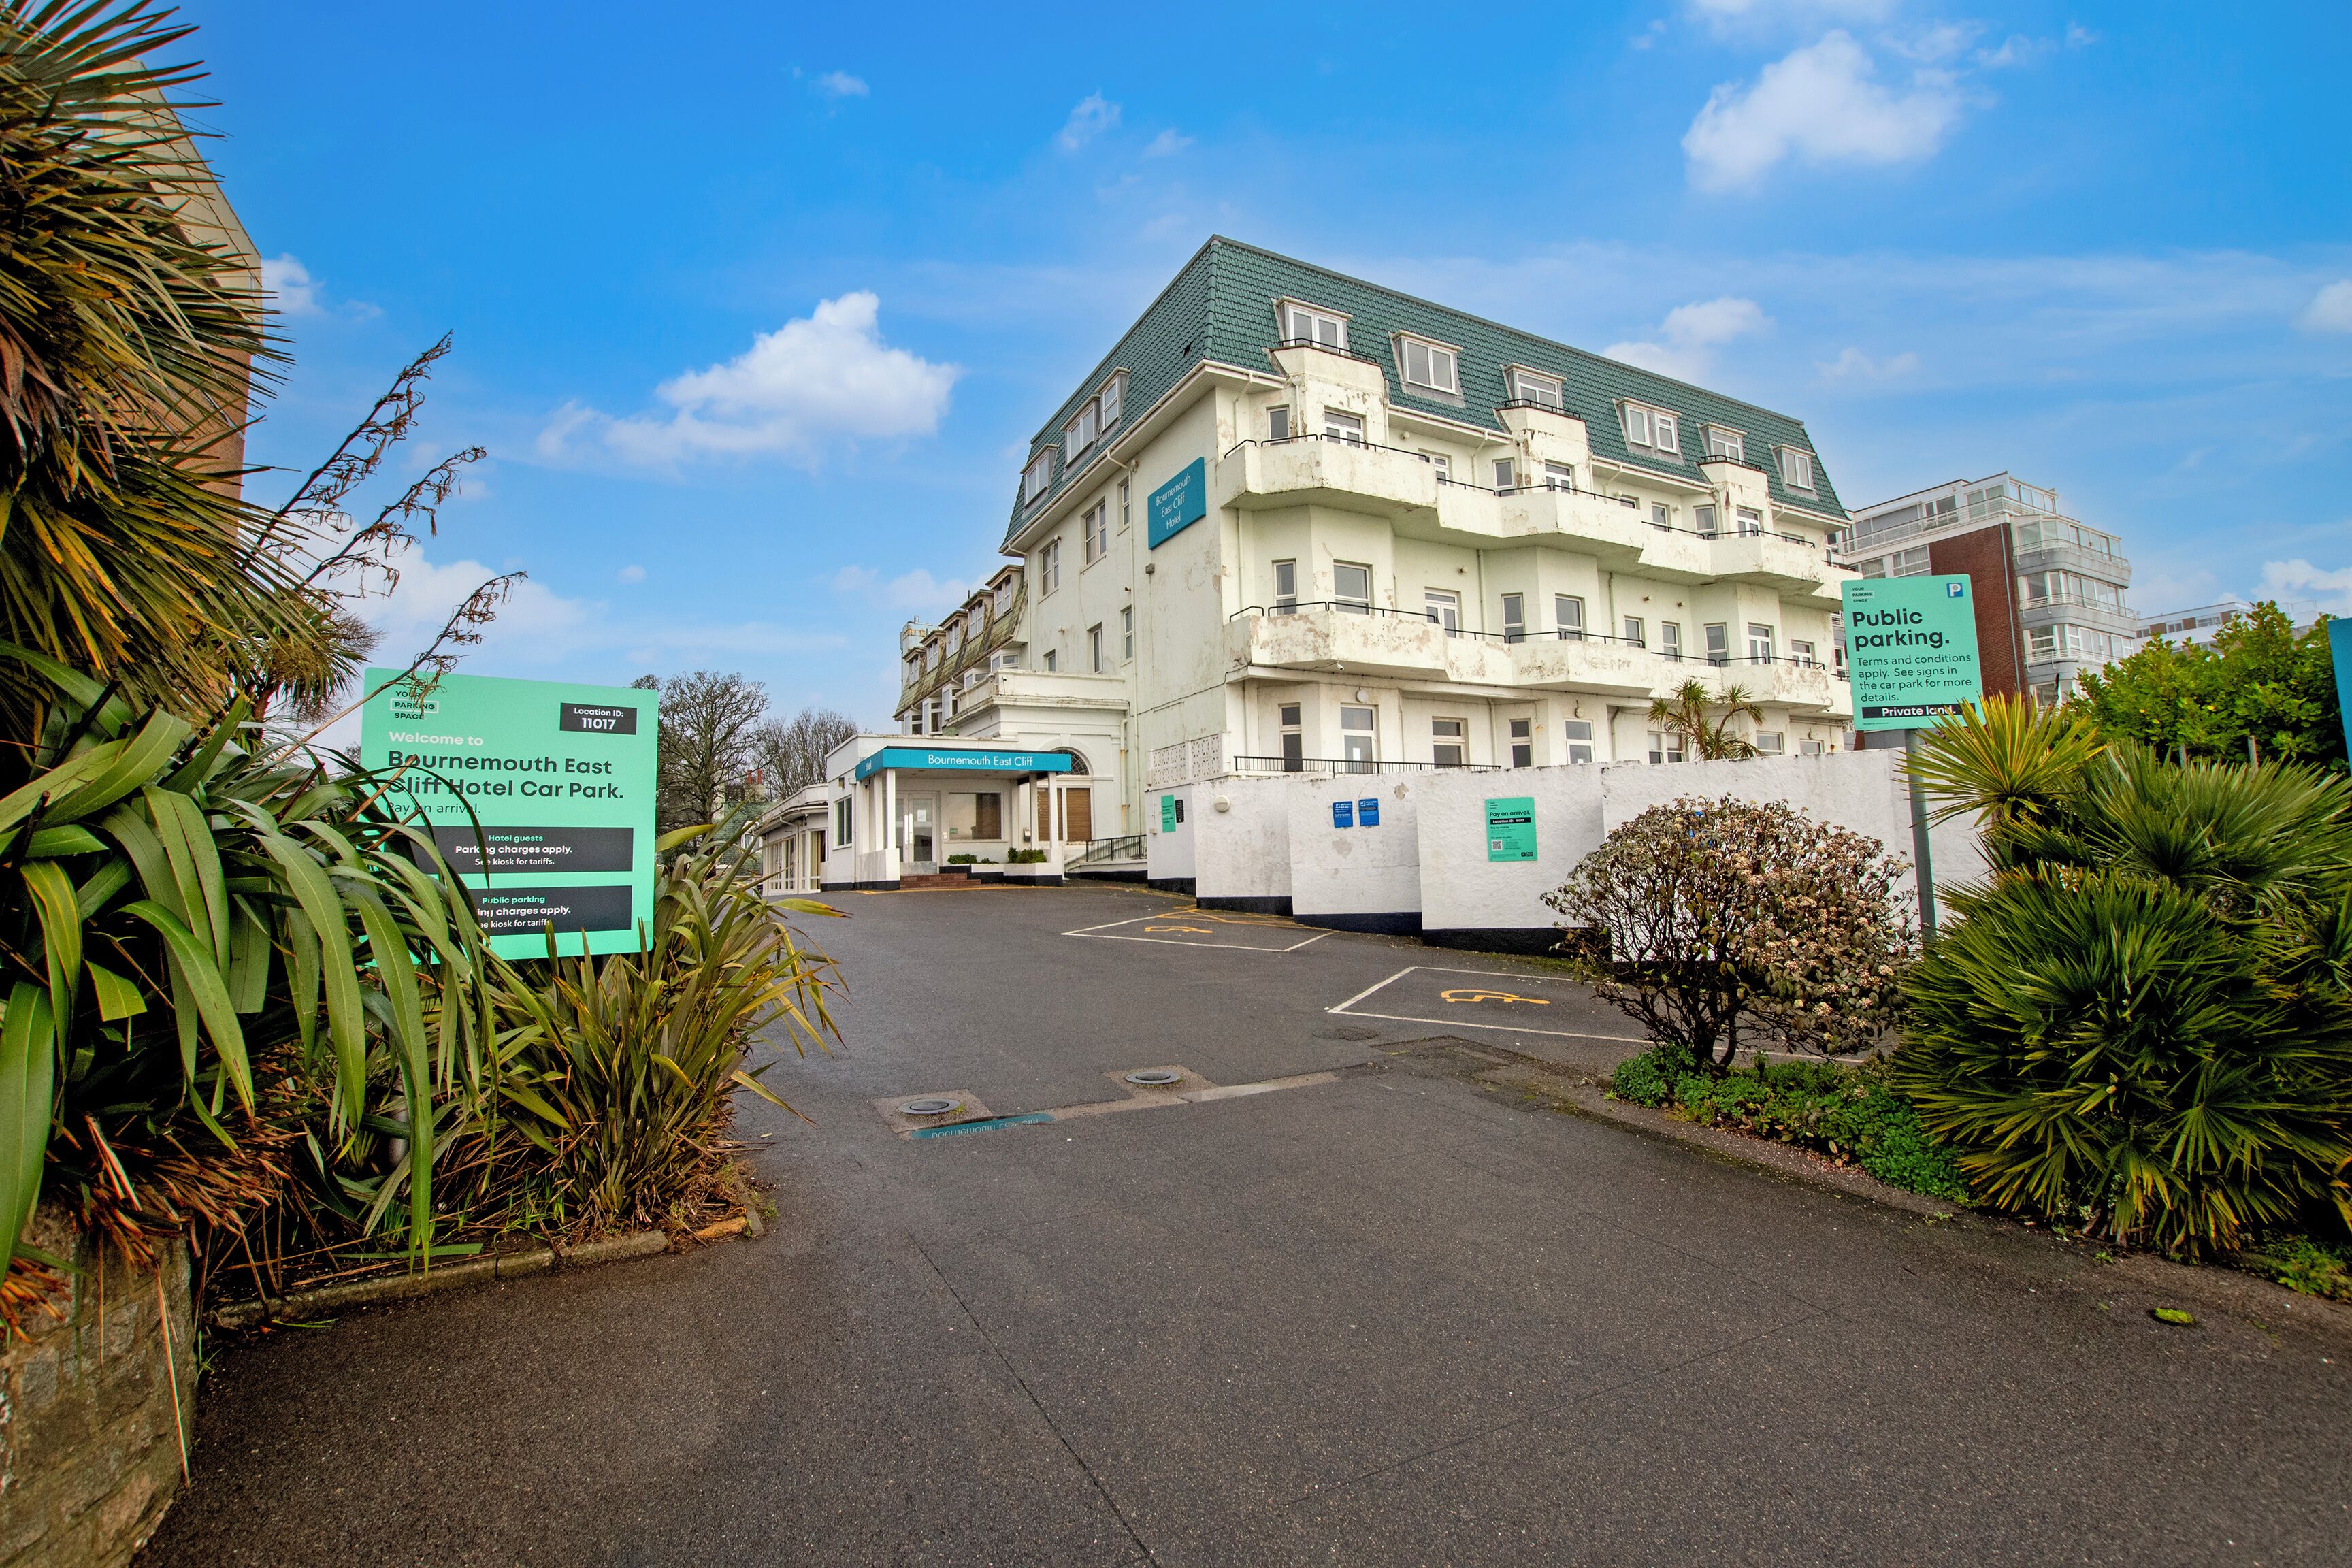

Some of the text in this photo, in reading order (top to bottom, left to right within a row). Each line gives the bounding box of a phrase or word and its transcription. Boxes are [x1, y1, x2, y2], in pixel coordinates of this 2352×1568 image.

[1156, 473, 1191, 506] Bournemouth
[1161, 491, 1185, 518] East Cliff
[1166, 511, 1181, 529] Hotel
[1852, 608, 1923, 627] Public
[1855, 629, 1950, 651] parking.
[1857, 654, 1971, 666] Terms and conditions
[1859, 666, 1957, 680] apply. See signs in
[1859, 681, 1877, 690] the
[1899, 679, 1923, 691] park
[1925, 679, 1941, 687] for
[1861, 692, 1899, 702] details.
[574, 708, 611, 716] Location
[1882, 705, 1956, 717] Private land.
[582, 717, 616, 730] 11017
[389, 731, 484, 746] Welcome to
[389, 751, 612, 774] Bournemouth East
[928, 754, 1033, 766] Bournemouth East Cliff
[388, 777, 623, 798] Cliff Hotel Car Park.
[436, 803, 480, 813] arrivl.
[514, 835, 544, 843] guests
[455, 845, 573, 855] Parkng charges apply.
[511, 896, 545, 904] parking
[495, 907, 538, 917] charges
[540, 906, 571, 915] apply.
